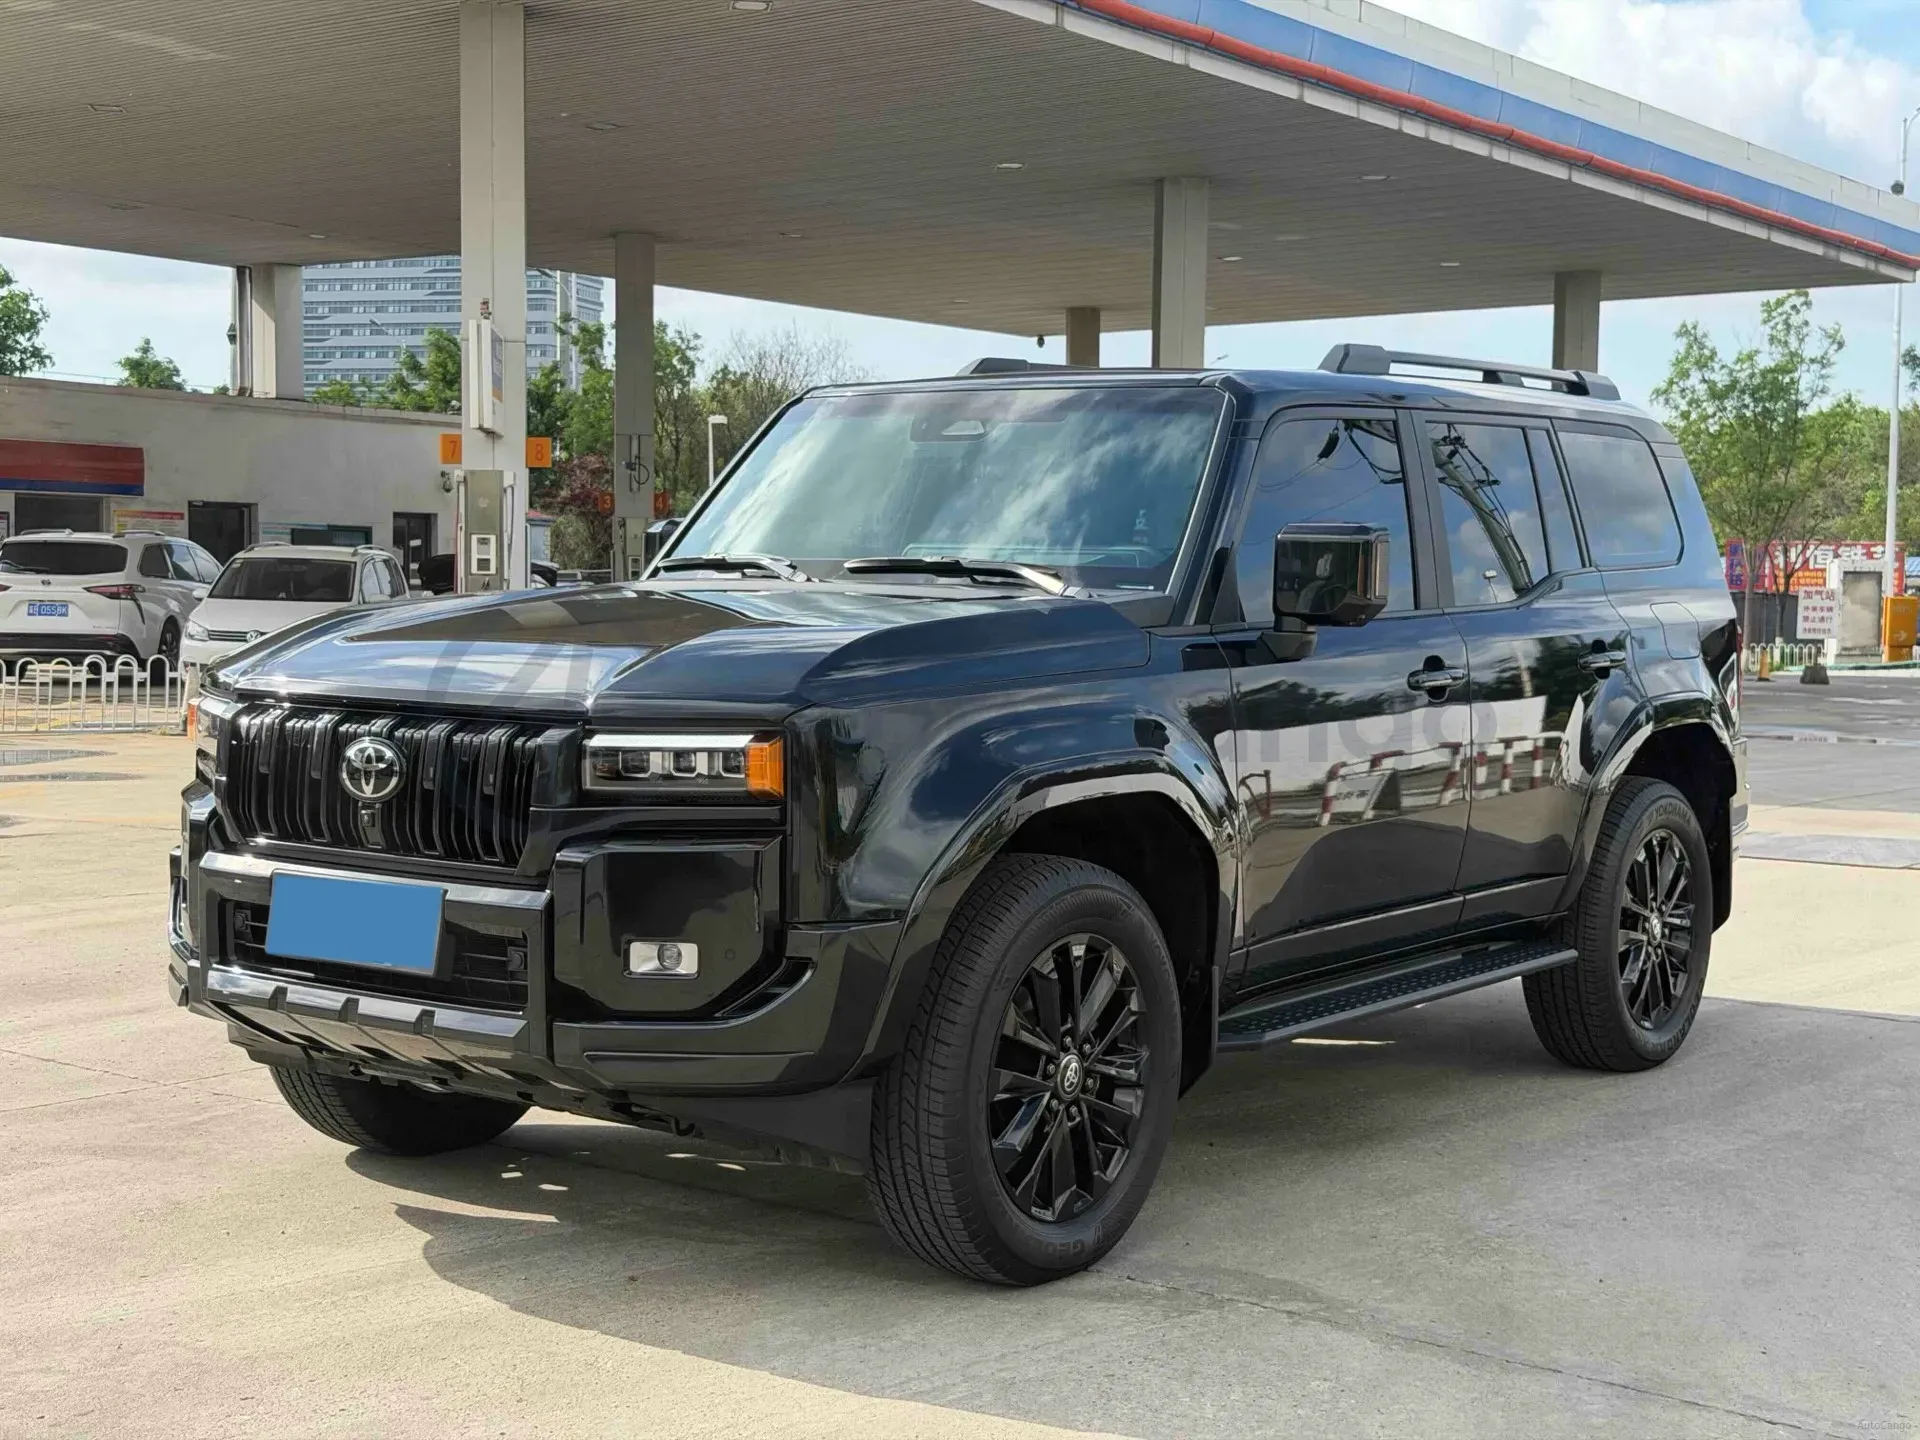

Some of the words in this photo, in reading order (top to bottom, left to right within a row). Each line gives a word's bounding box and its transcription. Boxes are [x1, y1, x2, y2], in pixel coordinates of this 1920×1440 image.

[449, 440, 458, 460] 7
[535, 443, 545, 462] 8
[603, 496, 611, 509] 3
[655, 496, 663, 510] 4
[1803, 589, 1835, 601] 加气站
[1654, 801, 1692, 826] YOKOHAMA
